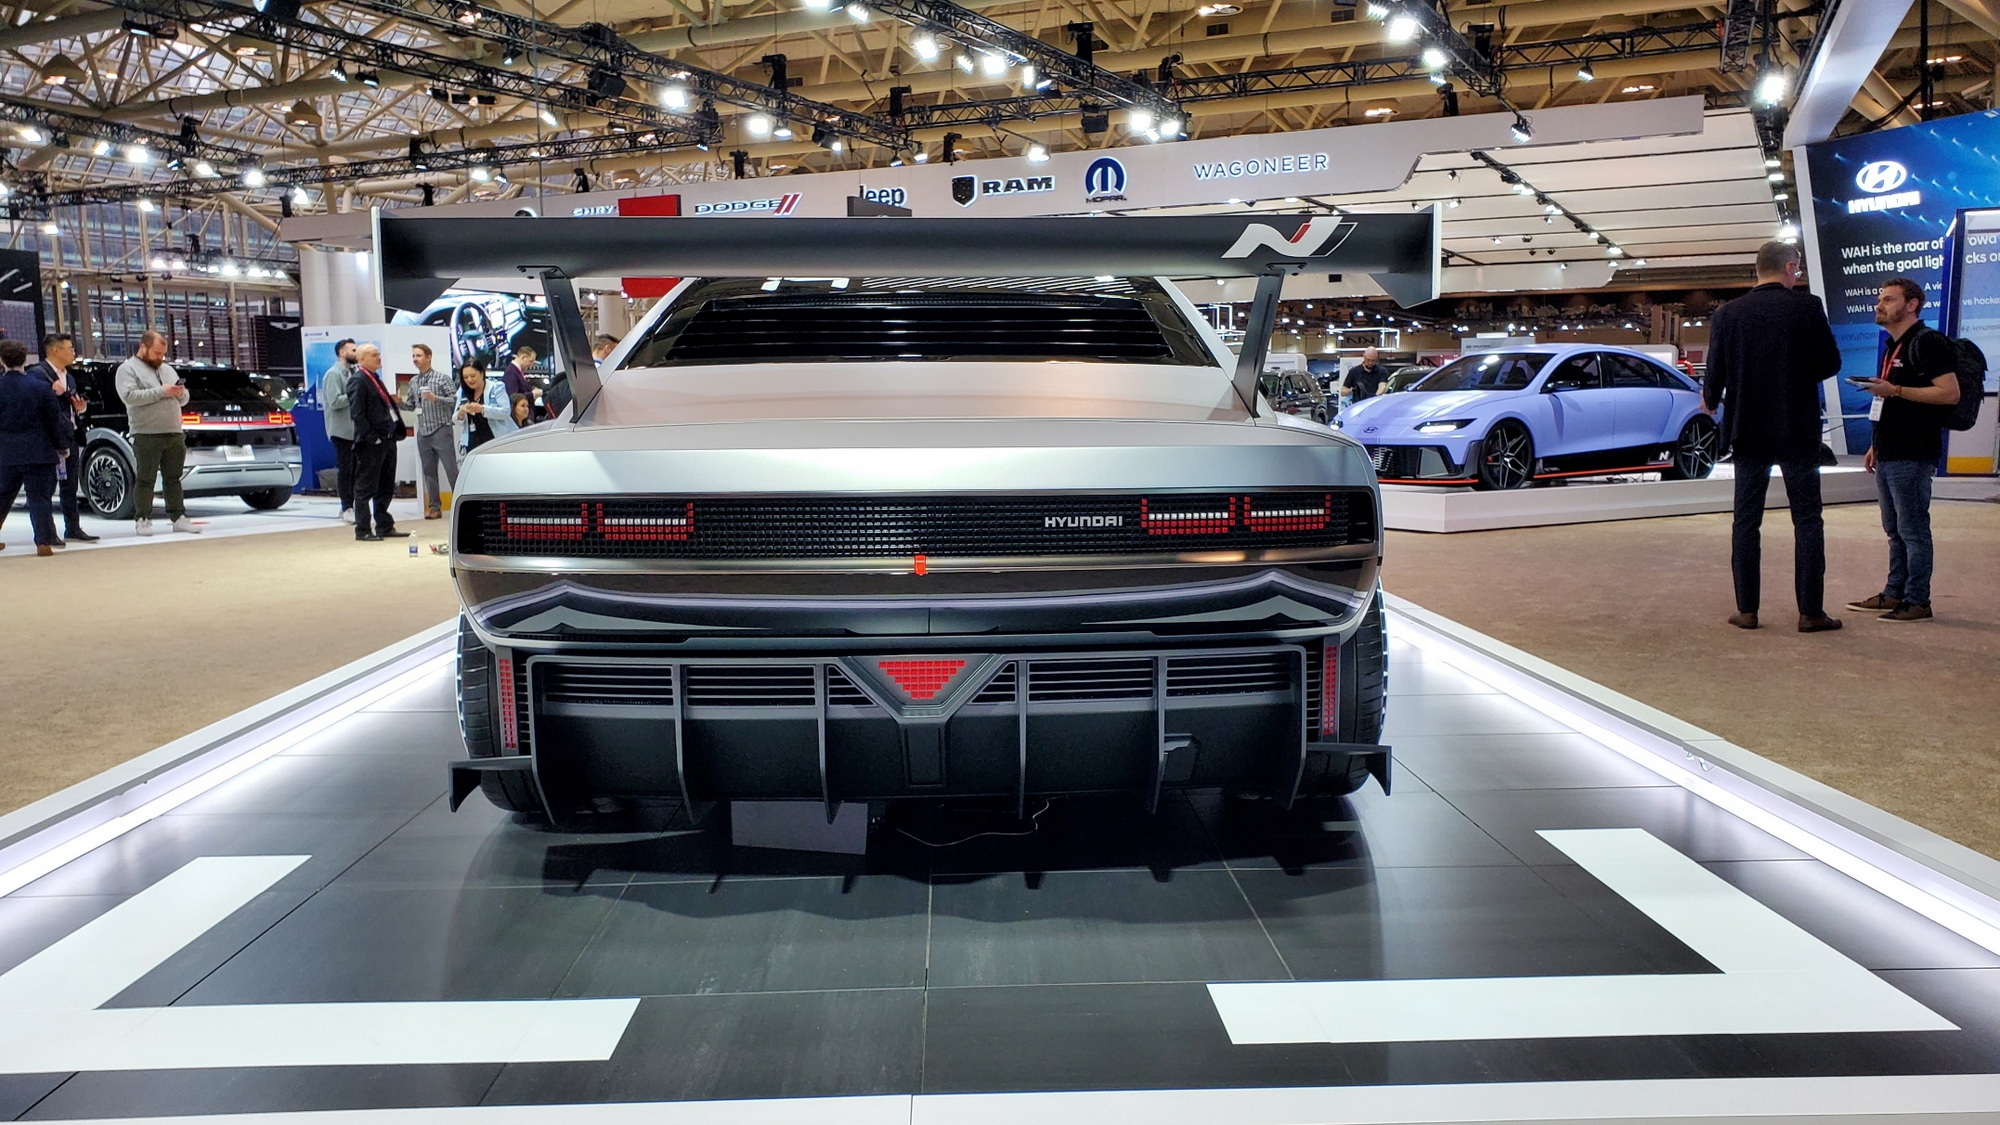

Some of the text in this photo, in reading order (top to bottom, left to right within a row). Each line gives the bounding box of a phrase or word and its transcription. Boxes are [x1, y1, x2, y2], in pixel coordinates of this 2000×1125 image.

[1193, 154, 1329, 180] WAGONEER
[982, 176, 1053, 195] RAM
[694, 198, 783, 214] DODGE
[1086, 195, 1124, 203] MOPAR
[1848, 191, 1920, 214] HYUNDAI
[572, 205, 619, 216] CHRY
[1841, 237, 1943, 259] WAH is the roar of
[1843, 262, 1874, 275] when
[1876, 260, 1895, 271] the
[1897, 256, 1923, 272] goal
[1845, 288, 1864, 297] WAH
[1865, 287, 1871, 295] is
[1847, 304, 1866, 313] WAH
[1867, 304, 1873, 312] is
[1044, 516, 1123, 528] HYUNDAI
